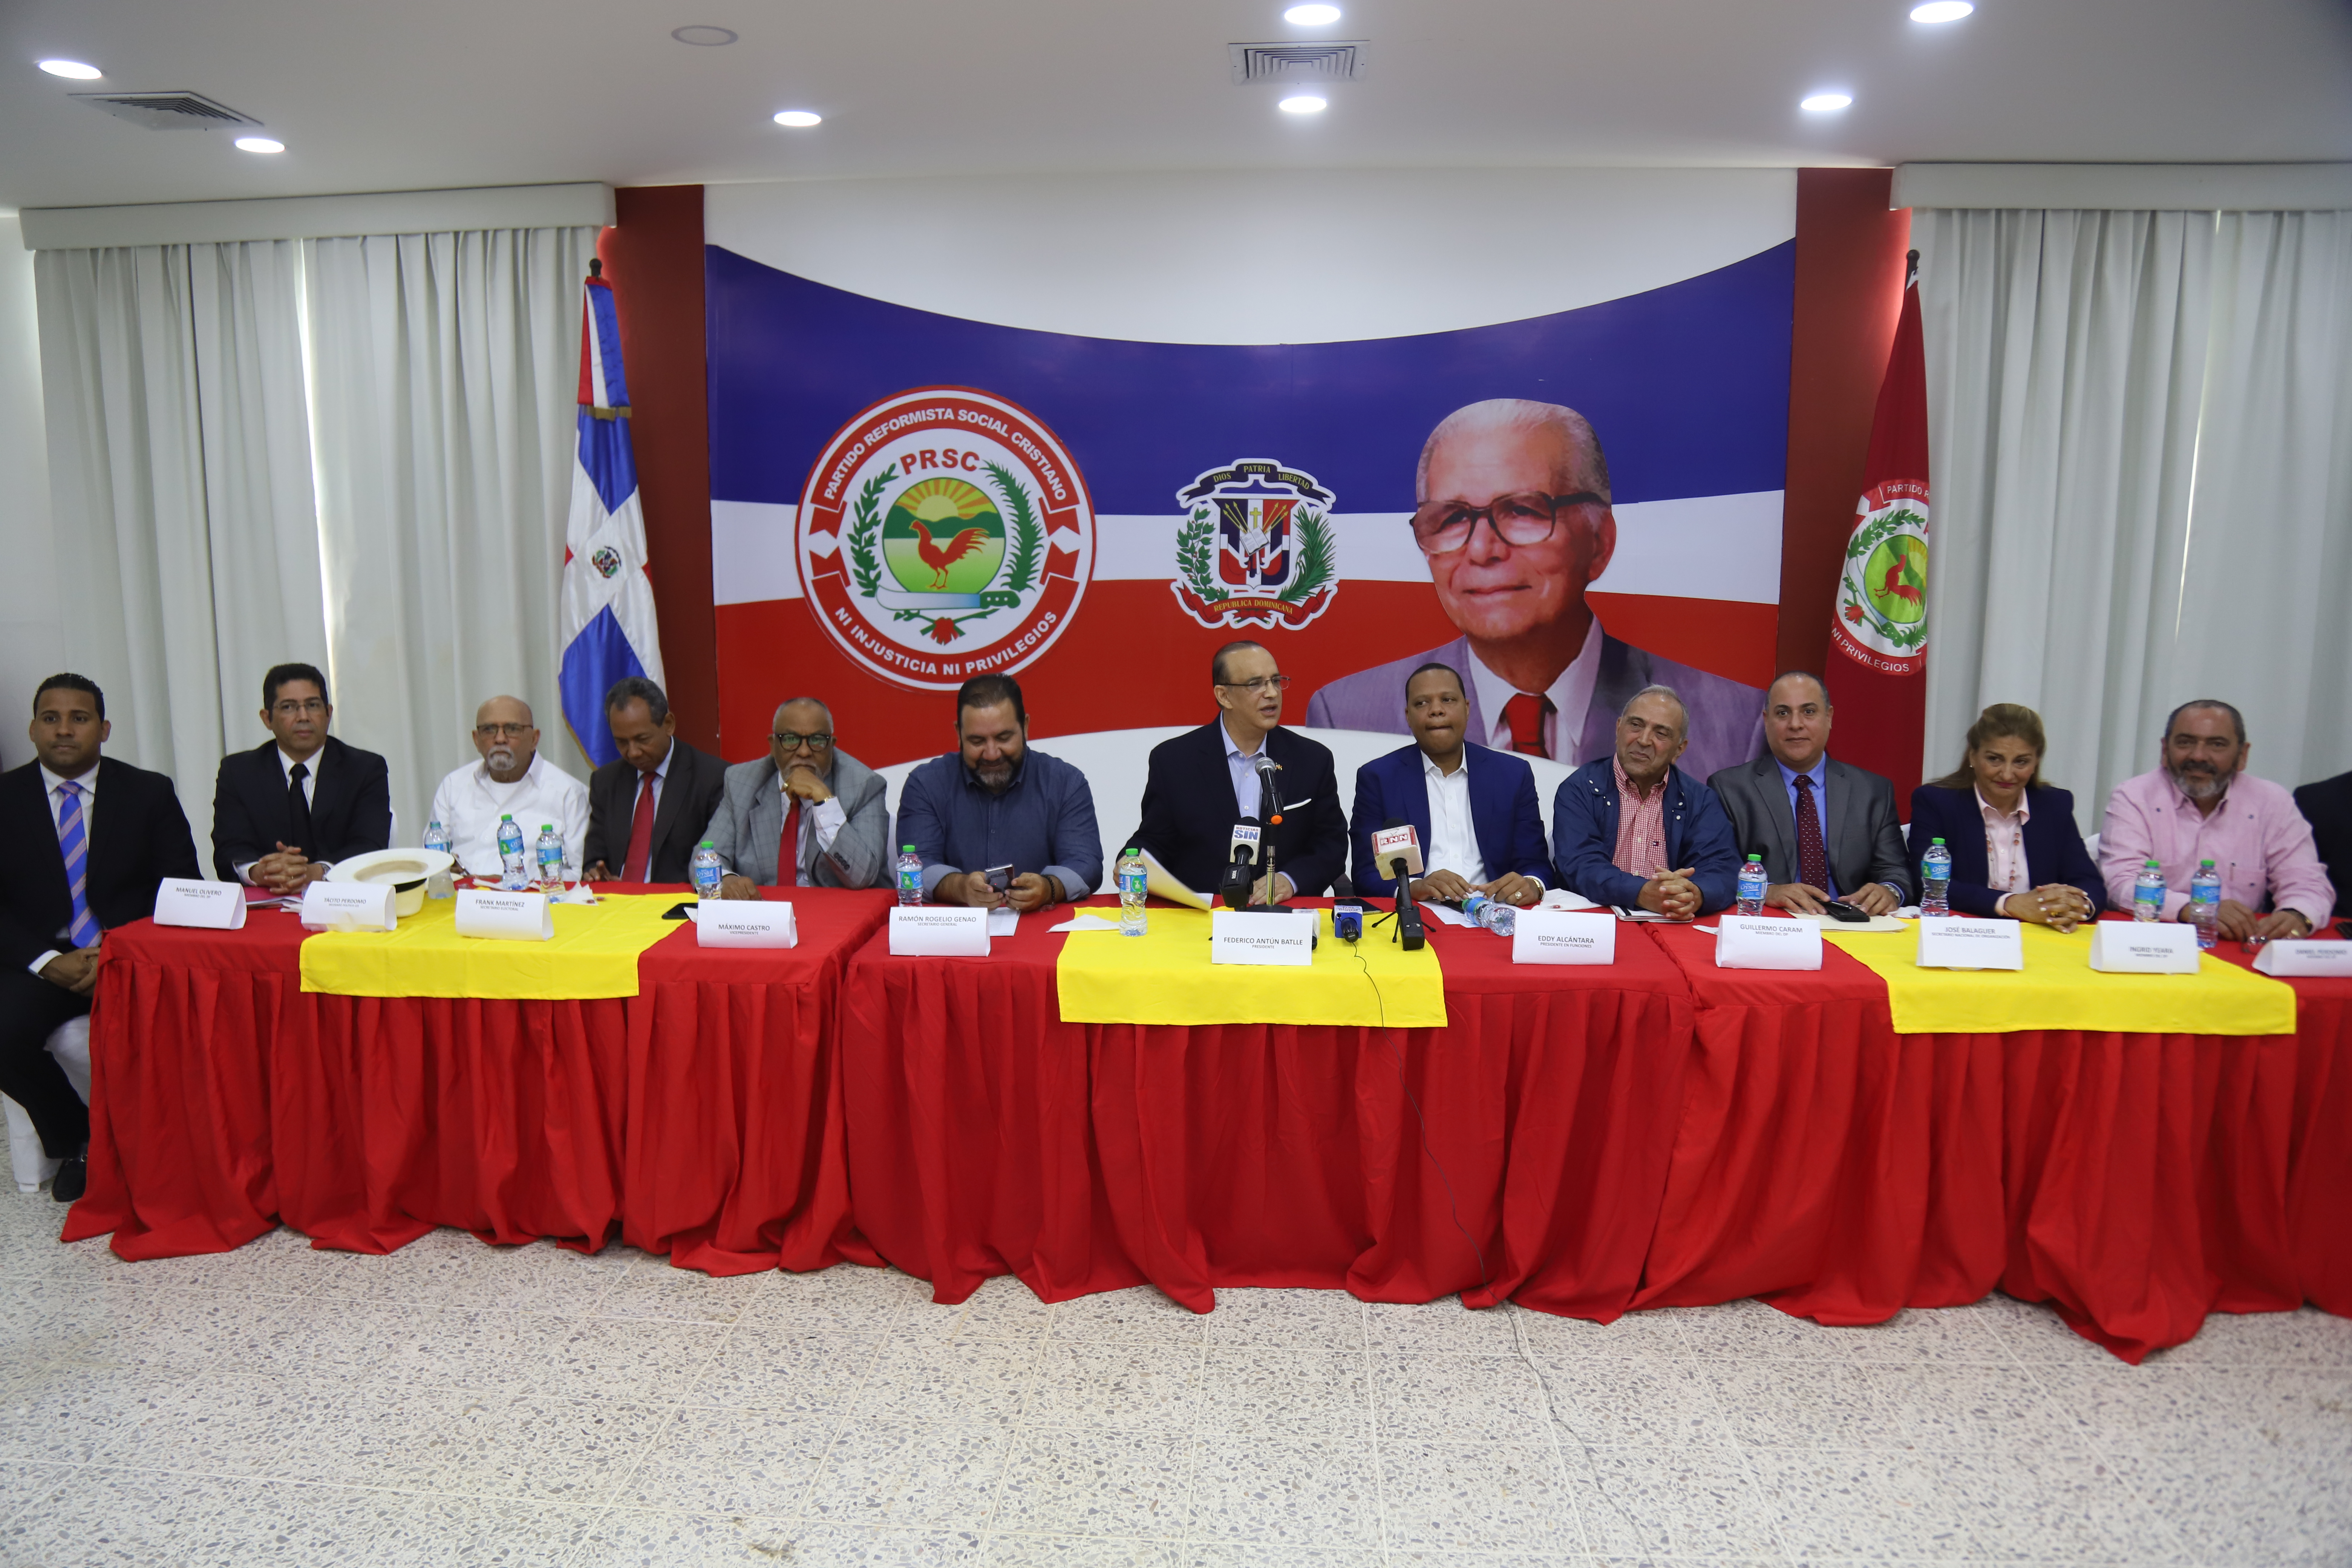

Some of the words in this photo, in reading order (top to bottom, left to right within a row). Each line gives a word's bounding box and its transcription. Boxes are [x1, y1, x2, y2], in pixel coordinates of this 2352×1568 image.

[824, 443, 865, 500] PARTIDO
[864, 407, 955, 447] REFORMISTA
[958, 409, 1009, 437] SOCIAL
[1012, 432, 1067, 501] CRISTIANO
[900, 448, 981, 476] PRSC
[1214, 472, 1231, 482] DIOS
[1279, 473, 1310, 490] LIBERTAD
[1887, 484, 1922, 495] PARTIDO
[1214, 599, 1252, 612] REPUBLICA
[1254, 599, 1294, 614] DOMINICANA
[835, 608, 851, 626] NI
[850, 621, 937, 675] INJUSTICIA
[943, 663, 960, 675] NI
[966, 611, 1057, 674] PRIVILEGIOS
[1831, 628, 1842, 641] NI
[1841, 639, 1909, 672] PRIVILEGIOS
[1234, 830, 1258, 840] SIN
[1380, 835, 1408, 845] RNN
